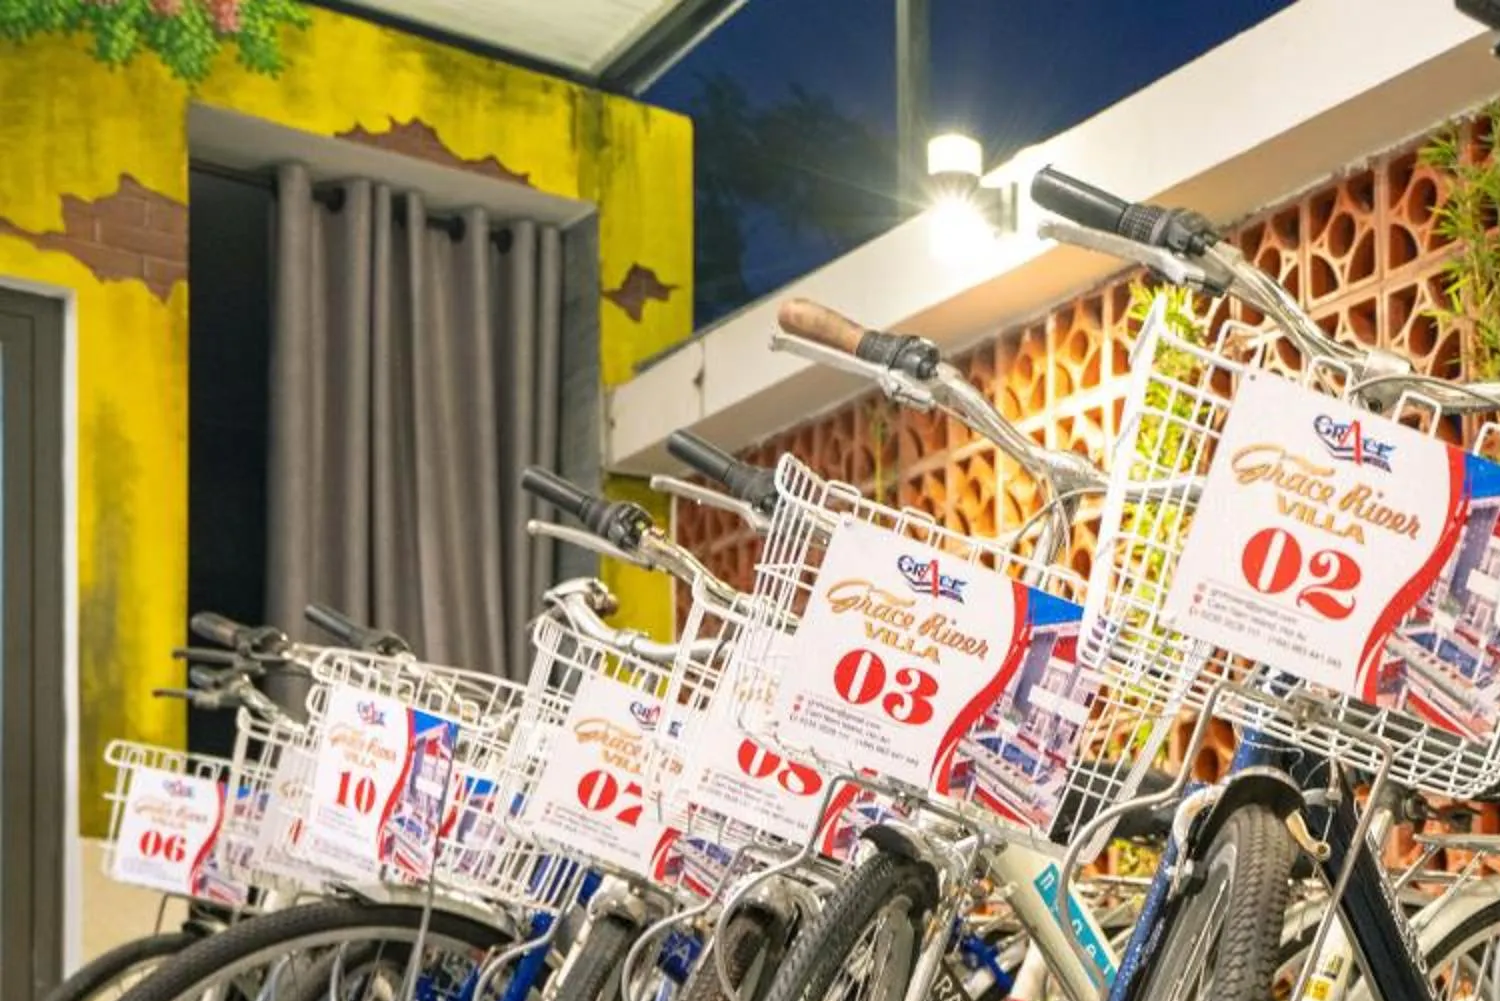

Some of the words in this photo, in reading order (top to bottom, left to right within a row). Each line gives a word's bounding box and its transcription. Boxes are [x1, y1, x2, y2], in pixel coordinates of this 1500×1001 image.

[1231, 442, 1335, 506] Grace
[1339, 482, 1422, 540] River
[1276, 491, 1365, 545] VILLA
[1240, 527, 1362, 621] 02
[827, 578, 916, 630] Grace
[918, 612, 990, 663] River
[864, 620, 942, 665] VILLA
[834, 648, 939, 726] 03
[336, 771, 377, 816] 10
[139, 830, 187, 863] 06
